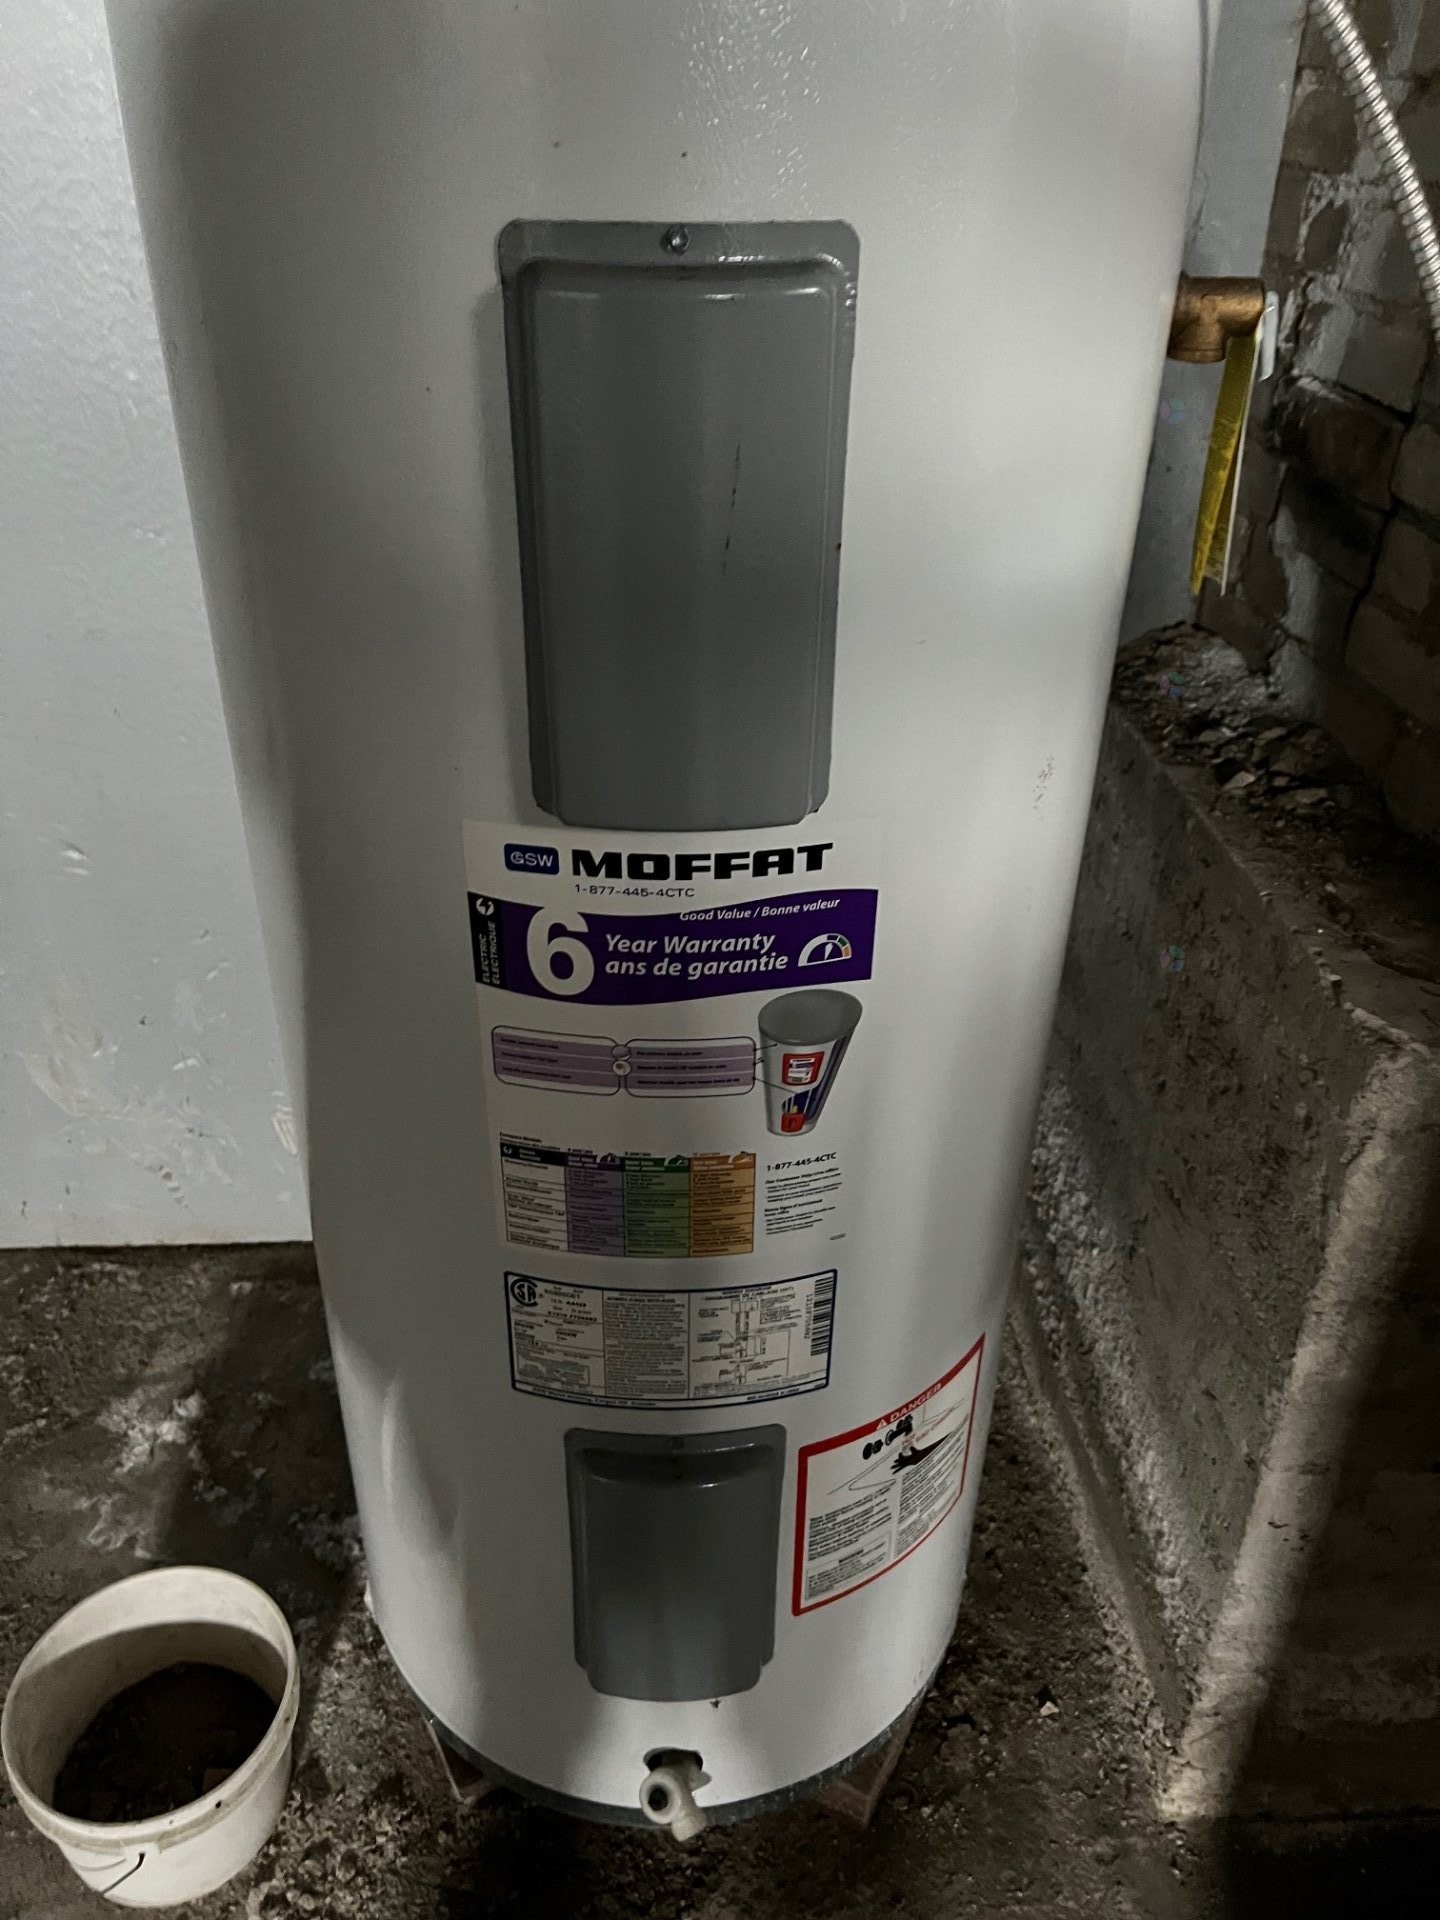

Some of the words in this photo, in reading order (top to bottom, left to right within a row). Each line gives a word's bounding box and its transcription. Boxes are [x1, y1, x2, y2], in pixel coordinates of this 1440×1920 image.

[510, 850, 554, 868] GSW
[571, 842, 834, 881] MOFFAT
[574, 883, 696, 898] 1-877-445-4CTC
[679, 909, 714, 921] Good
[717, 907, 751, 920] Value
[761, 904, 801, 917] Bonne
[802, 898, 841, 912] valeur
[479, 932, 491, 983] ELECTRIC
[526, 903, 595, 996] 6
[605, 933, 658, 953] Year
[663, 932, 776, 954] Warranty
[604, 959, 648, 976] ans
[652, 957, 682, 976] de
[688, 951, 789, 980] garantie
[889, 1382, 943, 1422] DANGER
